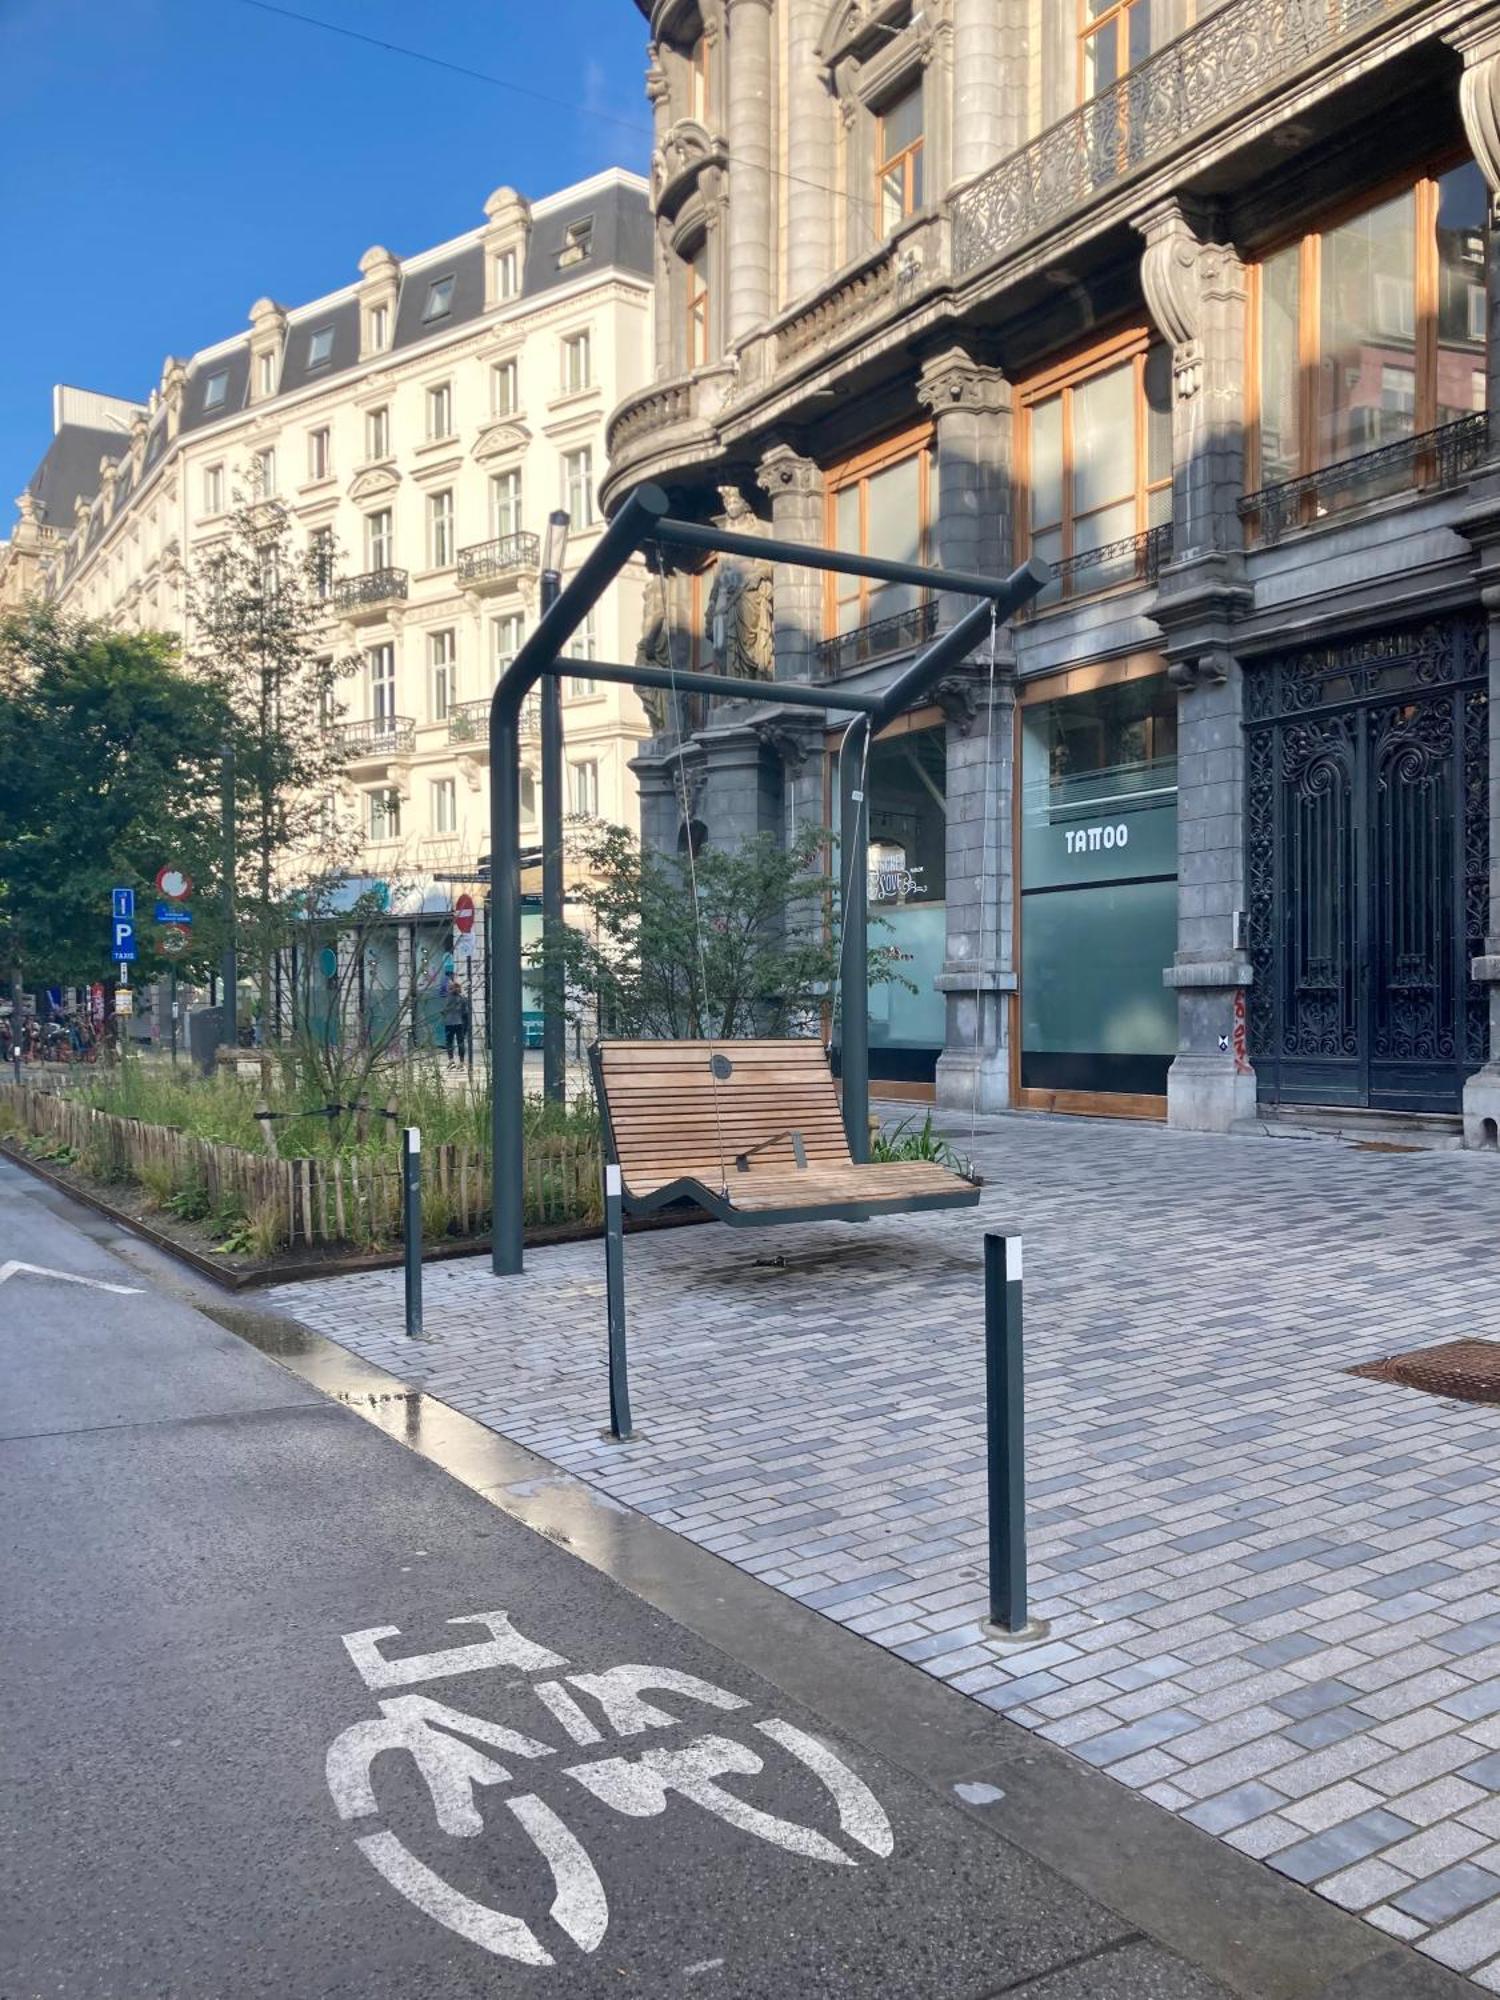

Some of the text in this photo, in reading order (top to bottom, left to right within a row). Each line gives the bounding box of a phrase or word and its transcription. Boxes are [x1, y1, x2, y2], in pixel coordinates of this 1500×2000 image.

[1065, 823, 1128, 854] TATTOO
[116, 923, 132, 946] P
[114, 952, 134, 960] TAXIS
